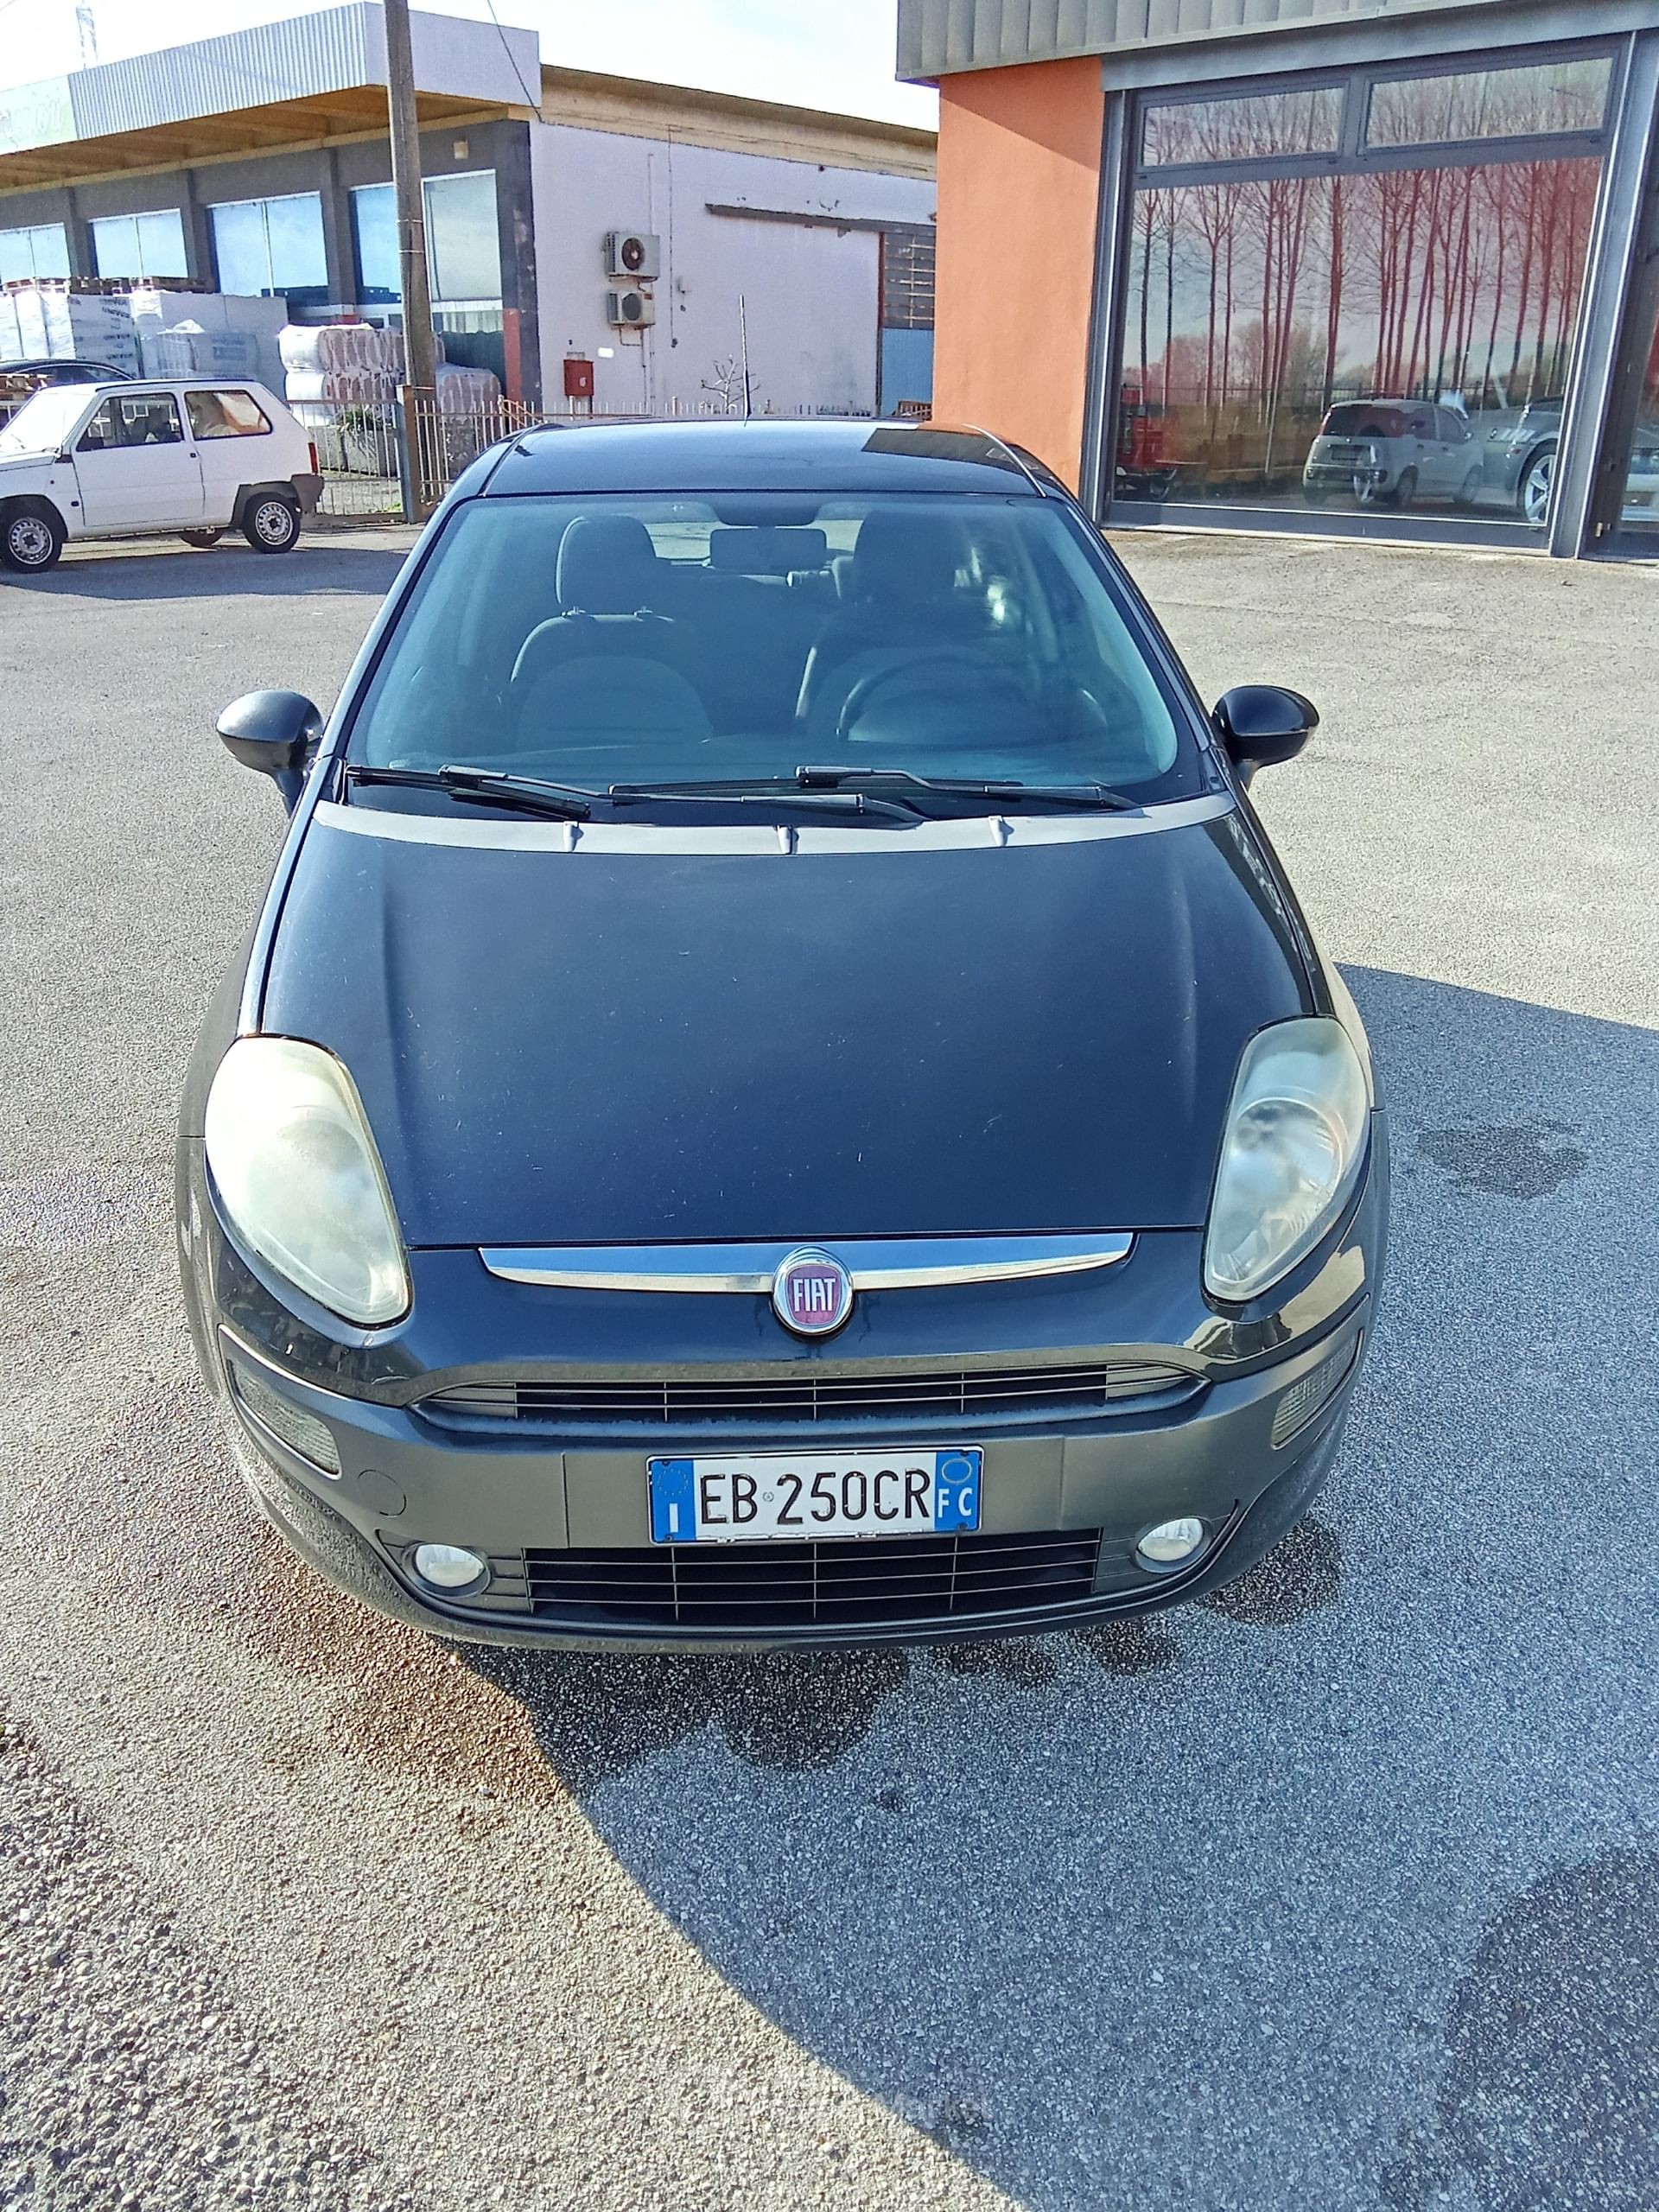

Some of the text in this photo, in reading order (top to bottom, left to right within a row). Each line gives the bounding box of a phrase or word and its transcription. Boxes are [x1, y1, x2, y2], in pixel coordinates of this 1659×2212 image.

[792, 1278, 836, 1313] FIAT
[699, 1468, 931, 1525] EB 250CR
